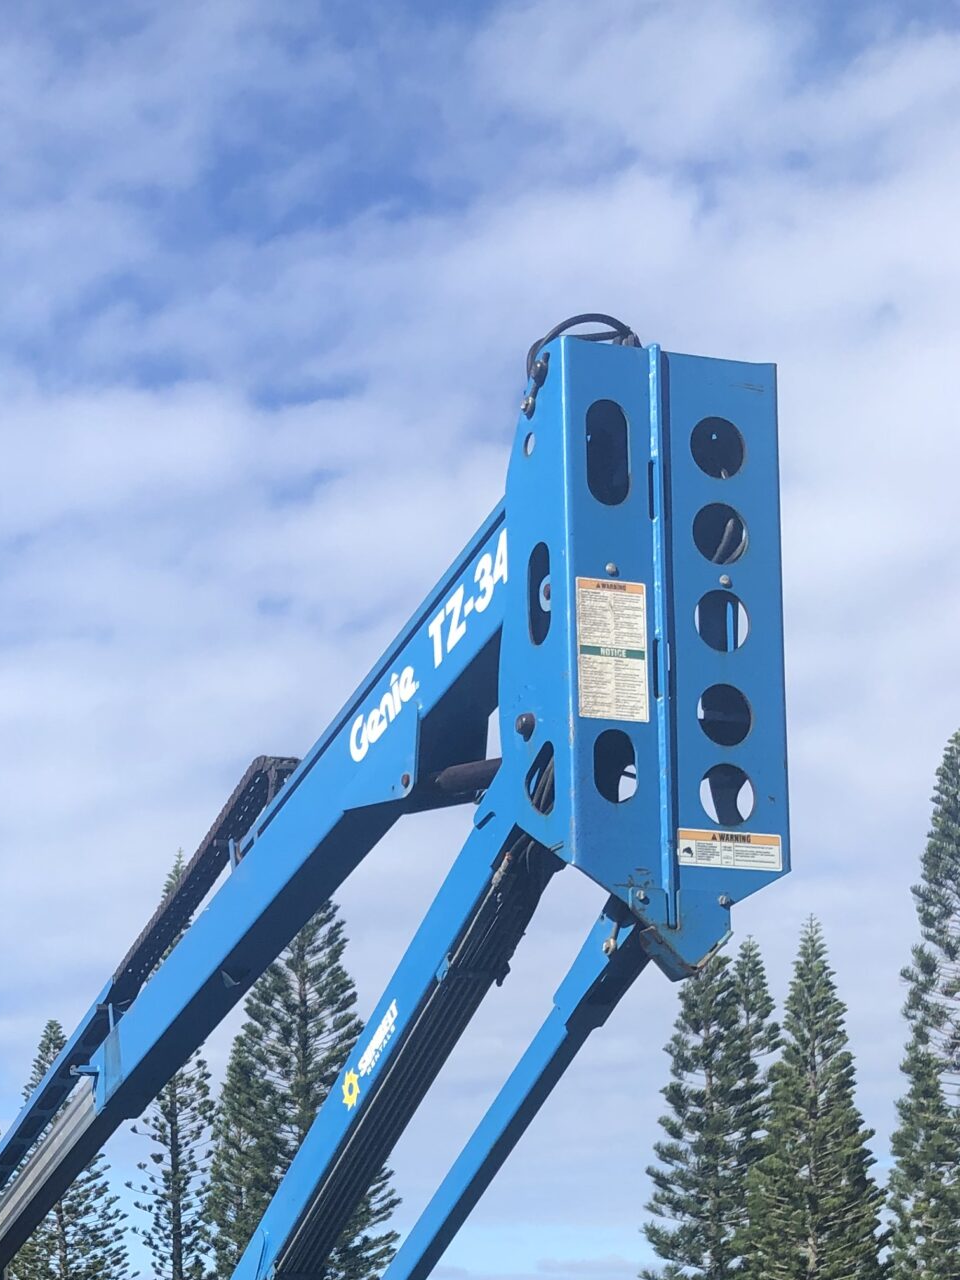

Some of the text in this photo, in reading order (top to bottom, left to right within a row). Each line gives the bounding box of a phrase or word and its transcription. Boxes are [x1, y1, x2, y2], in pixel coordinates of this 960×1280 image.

[428, 529, 508, 668] TZ-34
[600, 583, 627, 592] WARNING
[600, 648, 627, 658] NOTICE
[349, 665, 417, 763] Genie
[718, 833, 752, 844] WARNING
[366, 1024, 396, 1076] RENTALS
